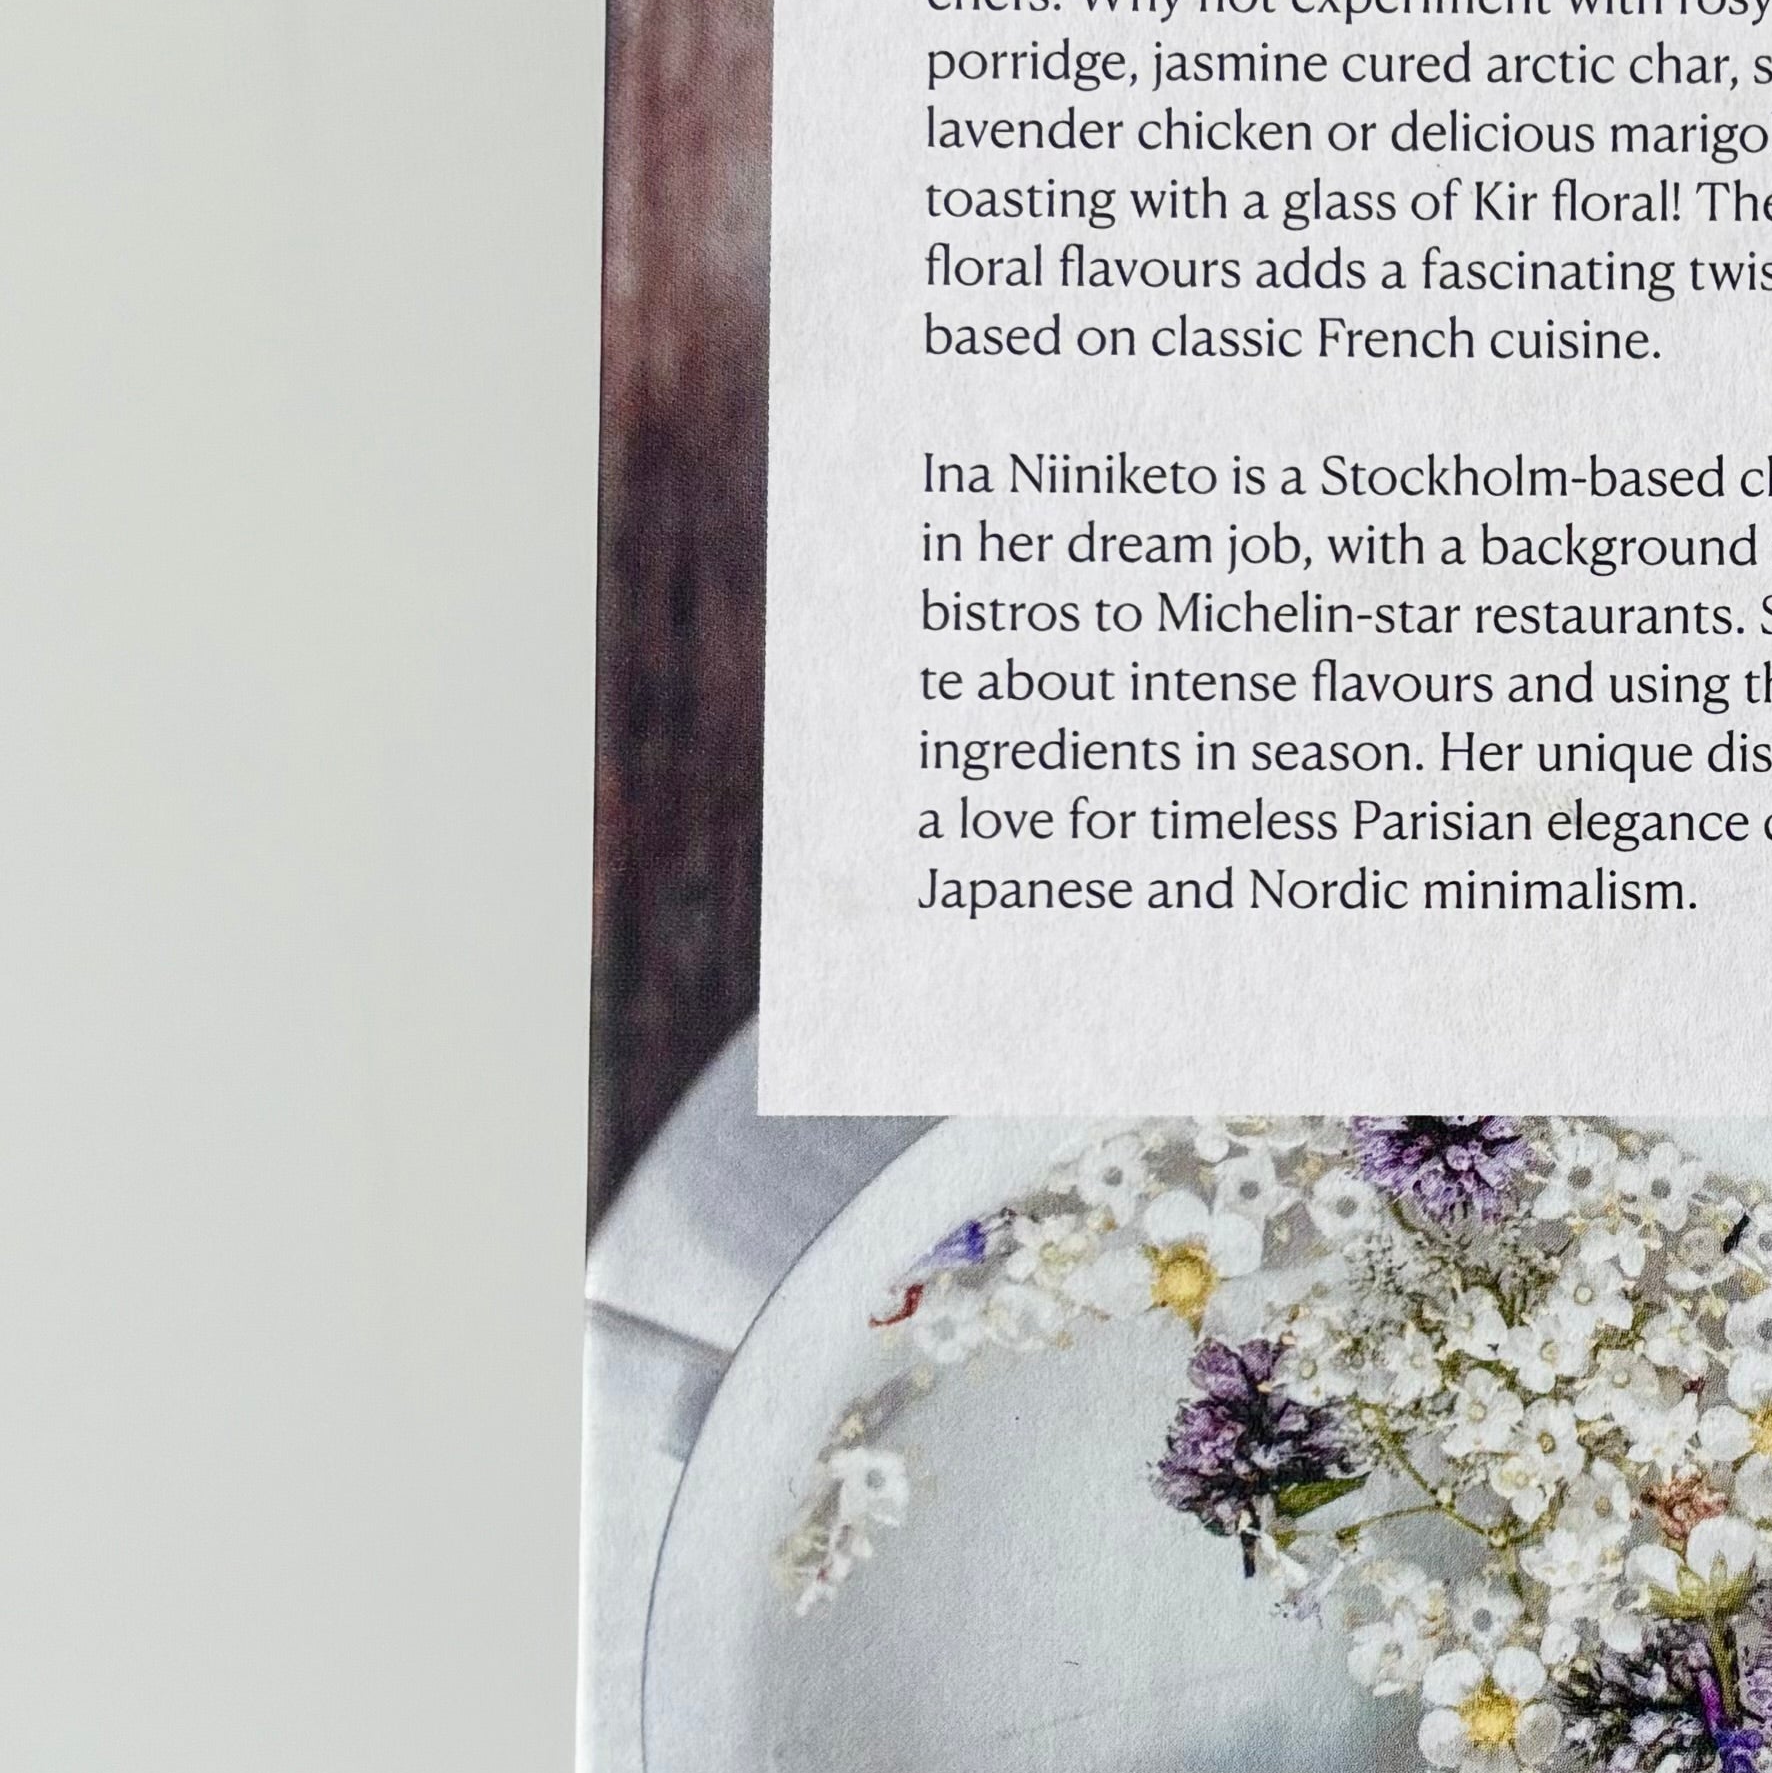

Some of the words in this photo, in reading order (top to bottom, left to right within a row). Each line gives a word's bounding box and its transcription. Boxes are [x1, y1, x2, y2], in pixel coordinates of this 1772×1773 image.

[927, 36, 1138, 92] porridge,
[1151, 40, 1328, 92] jasmine
[1342, 39, 1472, 84] cured
[1486, 43, 1616, 85] arctic
[1629, 39, 1739, 92] char,
[926, 104, 1124, 150] lavender
[1137, 106, 1313, 152] chicken
[1327, 121, 1377, 152] or
[1390, 108, 1595, 154] delicious
[925, 178, 1117, 230] toasting
[1129, 175, 1228, 220] with
[1243, 190, 1270, 220] a
[1282, 176, 1397, 232] glass
[1410, 176, 1463, 222] of
[1474, 180, 1538, 221] Kir
[1551, 177, 1681, 223] floral!
[924, 241, 1043, 287] floral
[1058, 242, 1241, 289] flavours
[1255, 245, 1367, 290] adds
[1380, 260, 1407, 290] a
[1421, 245, 1676, 303] fascinating
[923, 311, 1062, 357] based
[1076, 326, 1136, 357] on
[1151, 312, 1303, 358] classic
[1318, 314, 1475, 359] French
[1490, 318, 1661, 360] cuisine.
[923, 452, 995, 494] Ina
[1009, 450, 1218, 495] Niiniketo
[1232, 454, 1266, 496] is
[1280, 465, 1308, 496] a
[1320, 452, 1725, 498] Stockholm-based
[922, 521, 962, 562] in
[978, 518, 1054, 563] her
[1067, 519, 1213, 564] dream
[1227, 520, 1313, 575] job,
[1327, 520, 1425, 565] with
[1440, 535, 1467, 566] a
[1480, 521, 1758, 577] background
[921, 587, 1081, 633] bistros
[1094, 598, 1143, 633] to
[1157, 589, 1461, 634] Michelin-star
[1475, 600, 1745, 635] restaurants.
[919, 667, 964, 701] te
[977, 656, 1116, 702] about
[1130, 660, 1297, 703] intense
[1311, 657, 1494, 703] flavours
[1507, 659, 1594, 704] and
[1608, 662, 1731, 715] using
[919, 726, 1181, 782] ingredients
[1195, 730, 1236, 771] in
[1251, 741, 1424, 772] season.
[1439, 731, 1524, 772] Her
[1536, 732, 1694, 784] unique
[918, 809, 945, 840] a
[960, 795, 1054, 840] love
[1068, 794, 1137, 840] for
[1149, 796, 1338, 841] timeless
[1353, 799, 1533, 841] Parisian
[1547, 796, 1750, 853] elegance
[917, 867, 1134, 920] Japanese
[1147, 865, 1235, 910] and
[1249, 865, 1409, 910] Nordic
[1423, 866, 1697, 911] minimalism.
